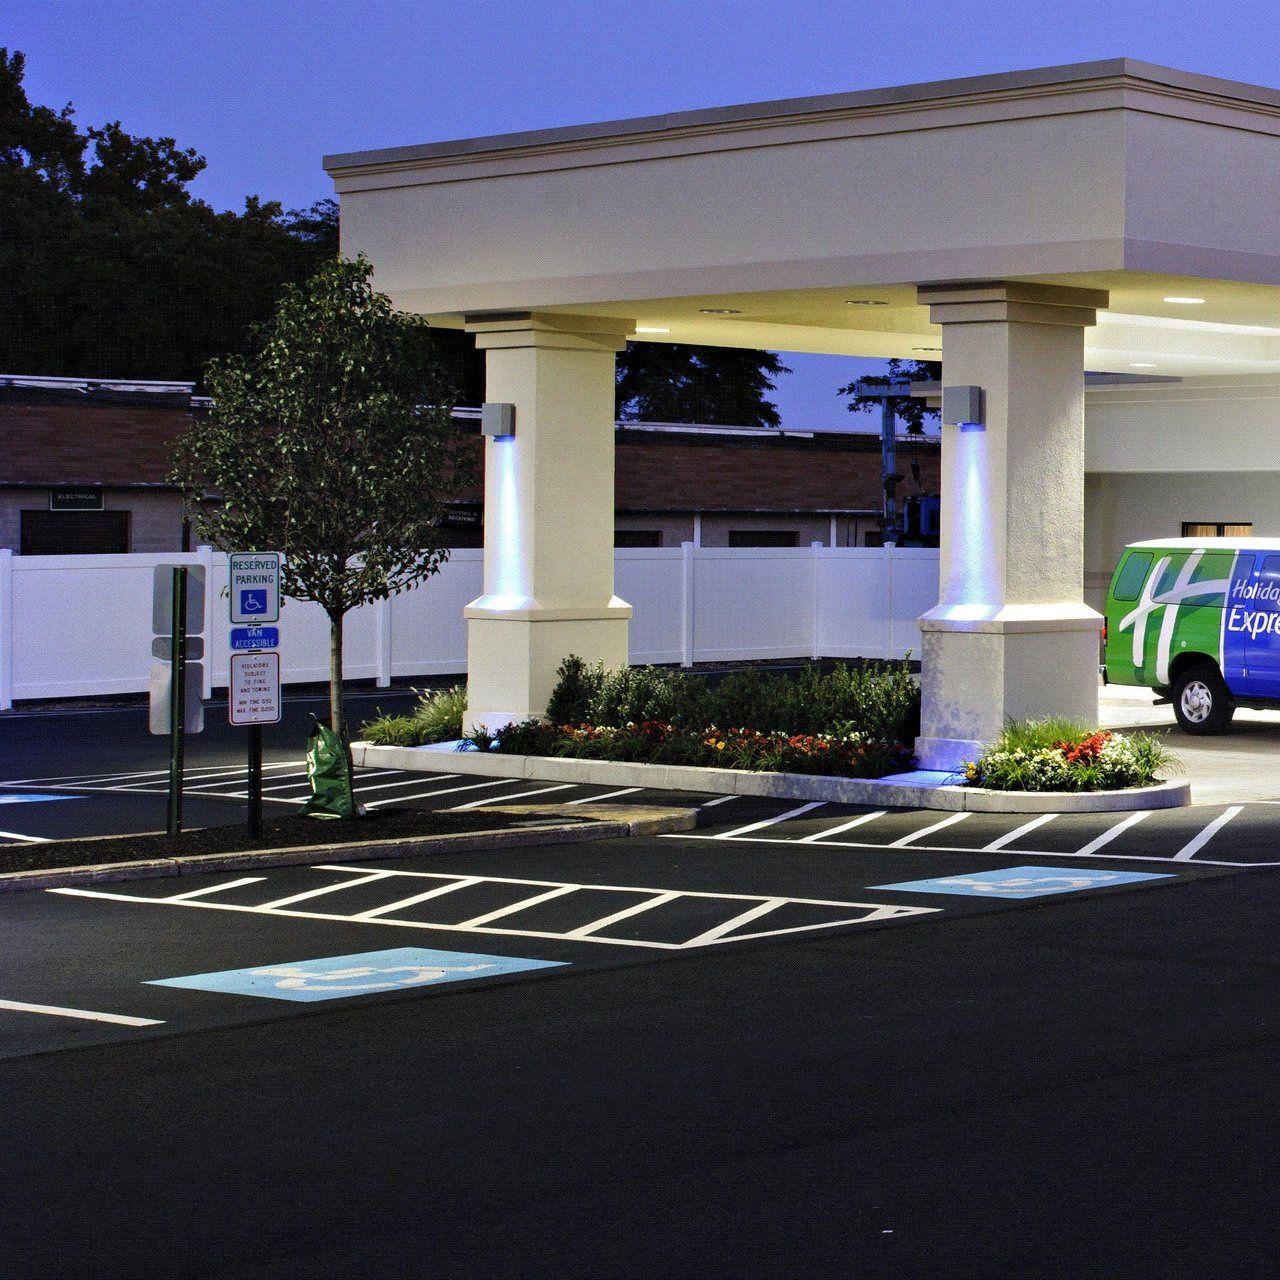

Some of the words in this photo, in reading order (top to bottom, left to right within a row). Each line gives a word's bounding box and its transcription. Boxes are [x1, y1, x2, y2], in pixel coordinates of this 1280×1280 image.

[233, 561, 277, 570] RESERVED
[235, 574, 274, 584] PARKING
[246, 628, 263, 637] VAN
[233, 638, 275, 648] ACCESSIBLE
